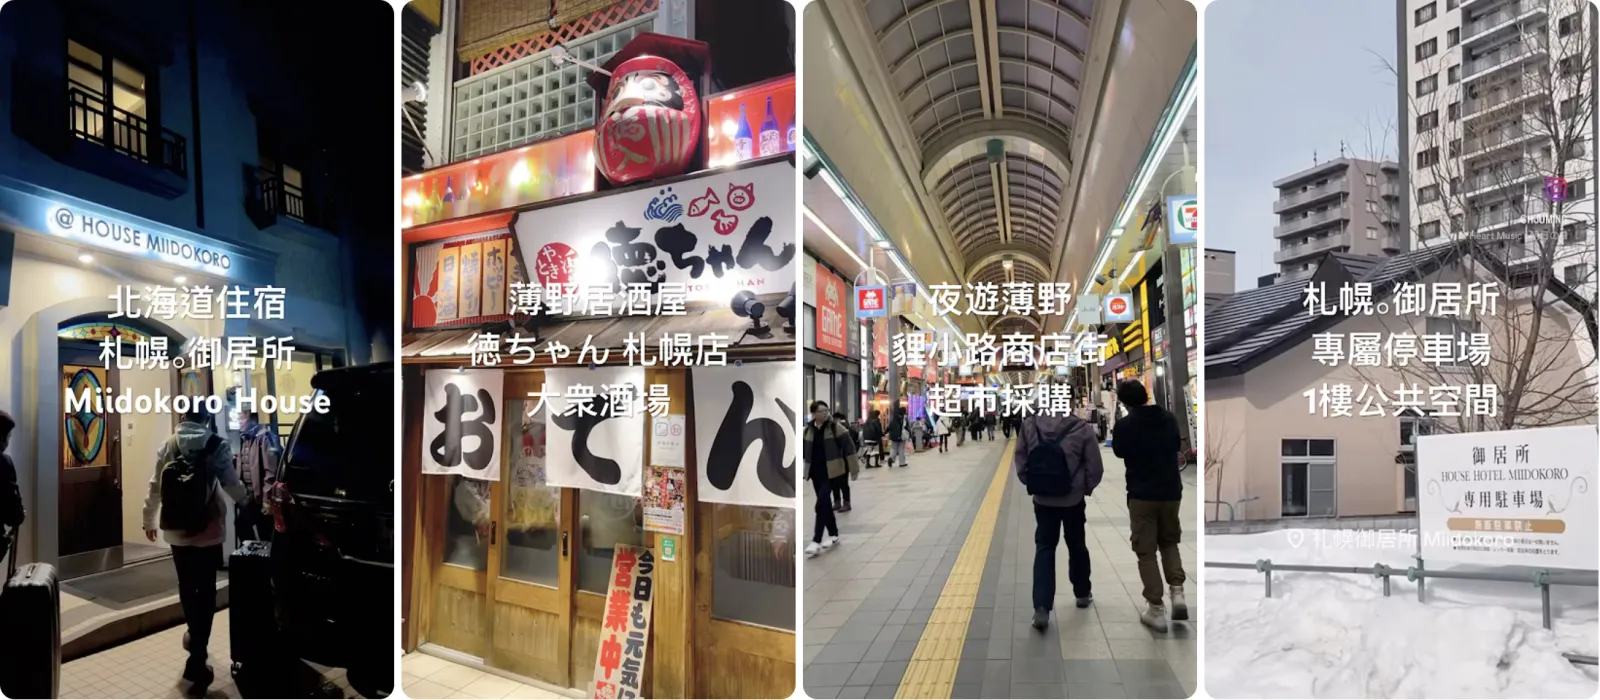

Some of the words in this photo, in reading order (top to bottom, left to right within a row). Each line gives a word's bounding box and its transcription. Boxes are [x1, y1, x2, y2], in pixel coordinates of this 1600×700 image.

[55, 207, 75, 230] @
[81, 215, 141, 247] HOUSE
[146, 234, 232, 270] MIIDOKORO
[1472, 444, 1530, 465] 御居所
[1441, 470, 1471, 482] HOUSE
[1473, 469, 1506, 481] HOTEL
[1508, 468, 1569, 481] MIIDOKORO
[1464, 490, 1544, 509] 専用駐車場
[600, 547, 637, 680] 営業中
